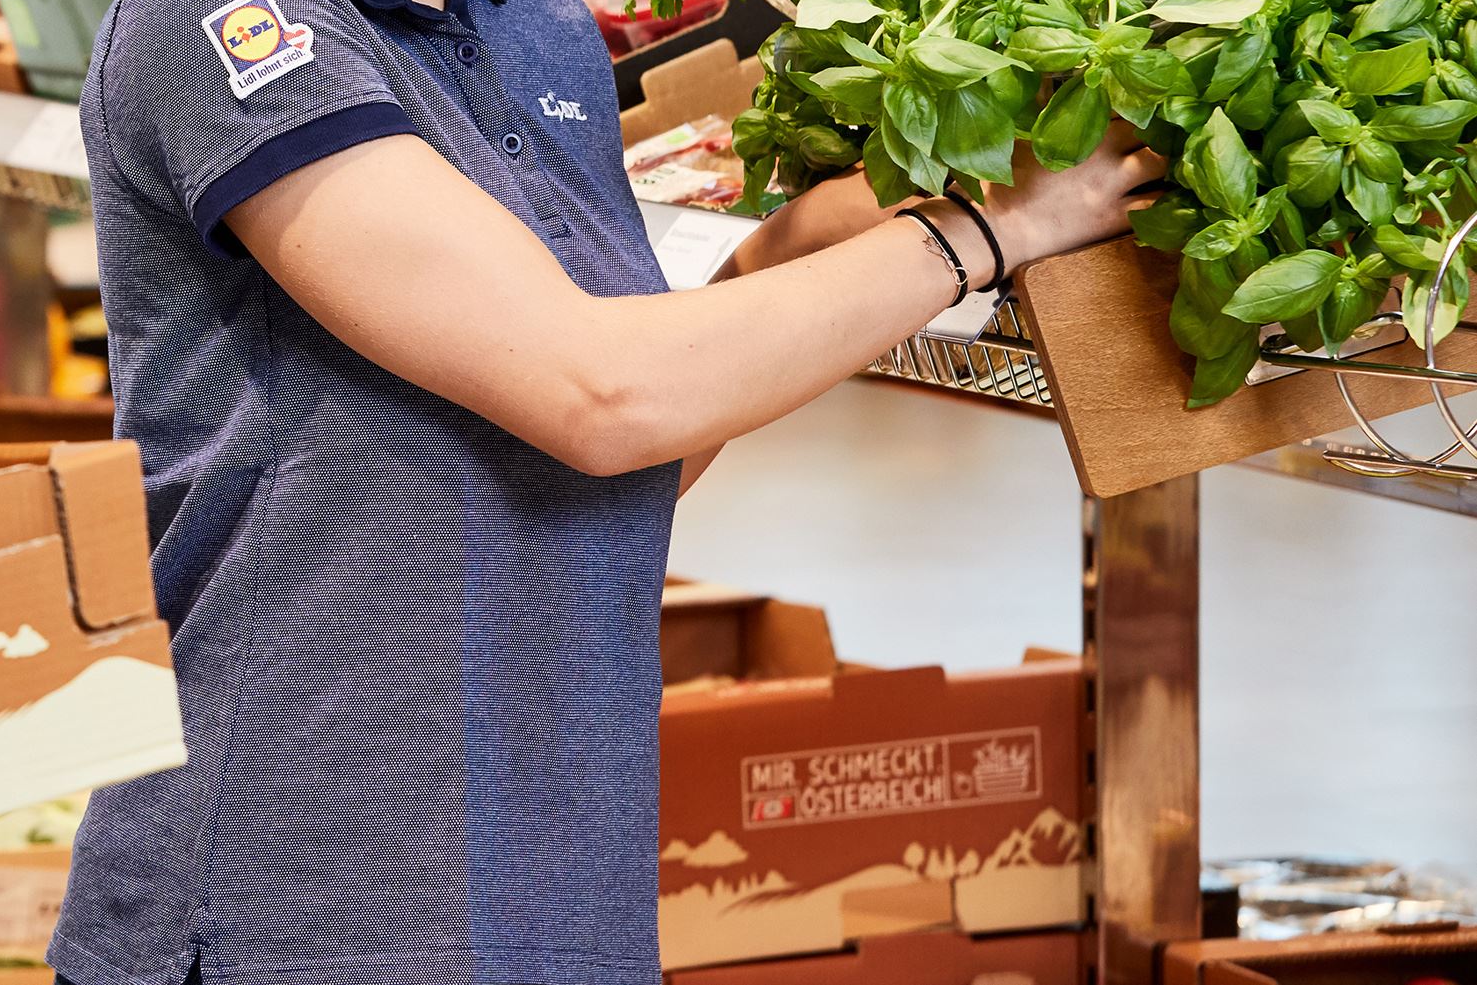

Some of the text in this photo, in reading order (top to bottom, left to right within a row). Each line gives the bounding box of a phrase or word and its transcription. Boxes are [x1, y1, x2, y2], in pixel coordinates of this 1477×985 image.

[237, 49, 306, 89] Lidl lohnt sich.
[752, 758, 801, 790] MIR.
[800, 776, 943, 816] ÖSTERREICH
